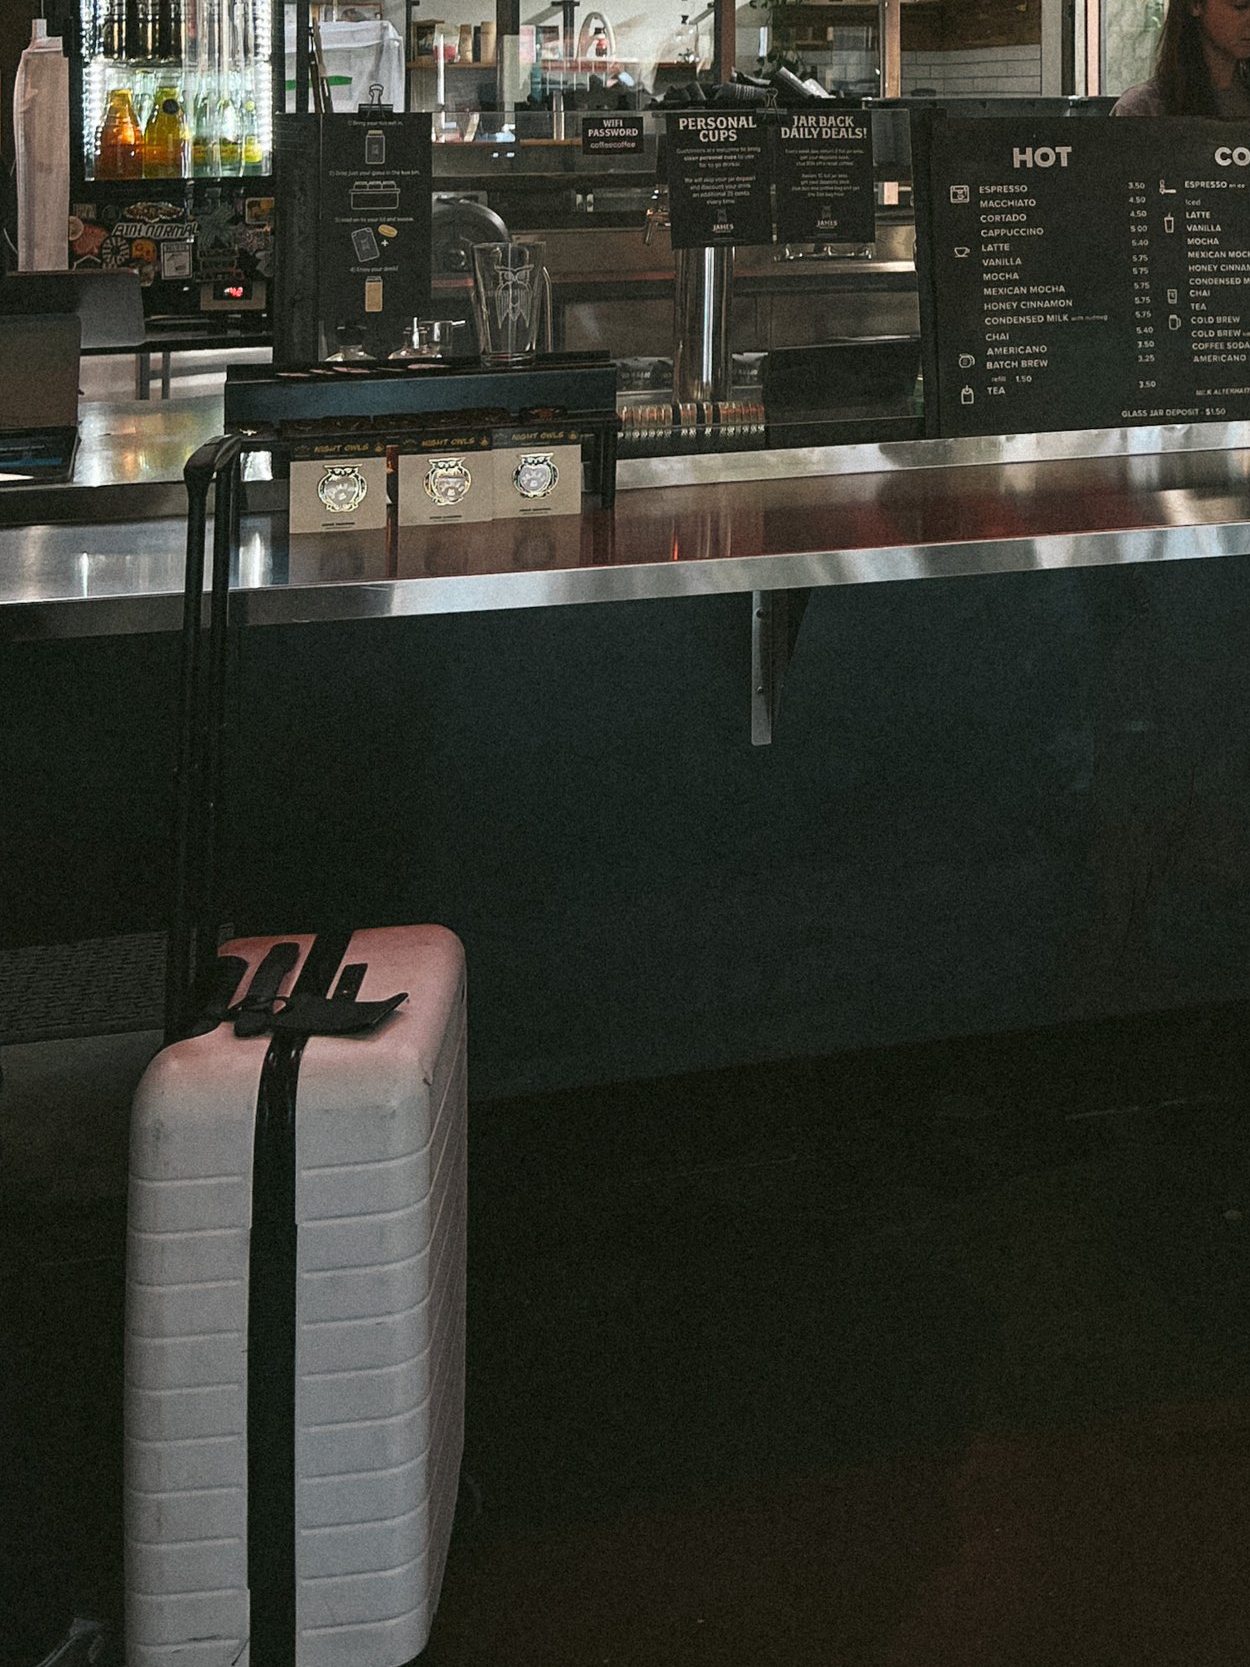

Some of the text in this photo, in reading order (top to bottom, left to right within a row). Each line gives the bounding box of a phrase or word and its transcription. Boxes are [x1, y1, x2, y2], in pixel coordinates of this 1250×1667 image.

[603, 119, 623, 127] WIFI
[679, 116, 757, 131] PERSONAL
[792, 116, 854, 127] JAR BACK
[588, 128, 639, 137] PASSWORD
[700, 129, 737, 142] CUPS
[781, 127, 867, 139] DAILY DEALS!
[1012, 146, 1072, 168] HOT
[1184, 180, 1228, 189] ESPRESSO
[979, 185, 1028, 194] ESPRESSO
[980, 199, 1036, 208] MACCHIATO
[1185, 198, 1201, 206] Iced
[980, 214, 1027, 223] CORTADO
[1185, 211, 1211, 219] LATTE
[981, 227, 1044, 238] CAPPUCCINO
[1186, 224, 1222, 232] VANILLA
[1187, 237, 1219, 245] MOCHA
[982, 243, 1010, 252] LATTE
[1187, 251, 1226, 259] MEXICAN
[982, 257, 1022, 267] VANILLA
[1188, 264, 1218, 272] HONEY
[983, 272, 1019, 281] MOCHA
[1189, 277, 1242, 285] CONDENSED
[984, 287, 1027, 296] MEXICAN
[1029, 285, 1066, 294] MOCHA
[1189, 289, 1211, 298] CHAI
[984, 301, 1018, 311] HONEY
[1020, 299, 1073, 309] CINNAMON
[1190, 302, 1207, 311] TEA
[985, 315, 1044, 326] CONDENSED
[1047, 314, 1069, 323] MILK
[1190, 316, 1214, 324] COLD
[1216, 316, 1241, 324] BREW
[986, 333, 1009, 341] CHAI
[1191, 330, 1215, 338] COLD
[1217, 329, 1241, 338] BREW
[986, 345, 1047, 356] AMERICANO
[1192, 342, 1225, 351] COFFEE
[1226, 341, 1250, 350] SODA
[1193, 354, 1247, 363] AMERICANO
[986, 360, 1018, 370] BATCH
[1021, 359, 1049, 368] BREW
[987, 387, 1006, 395] TEA
[1121, 409, 1148, 418] GLASS
[1149, 408, 1164, 417] JAR
[1165, 408, 1199, 417] DEPOSIT
